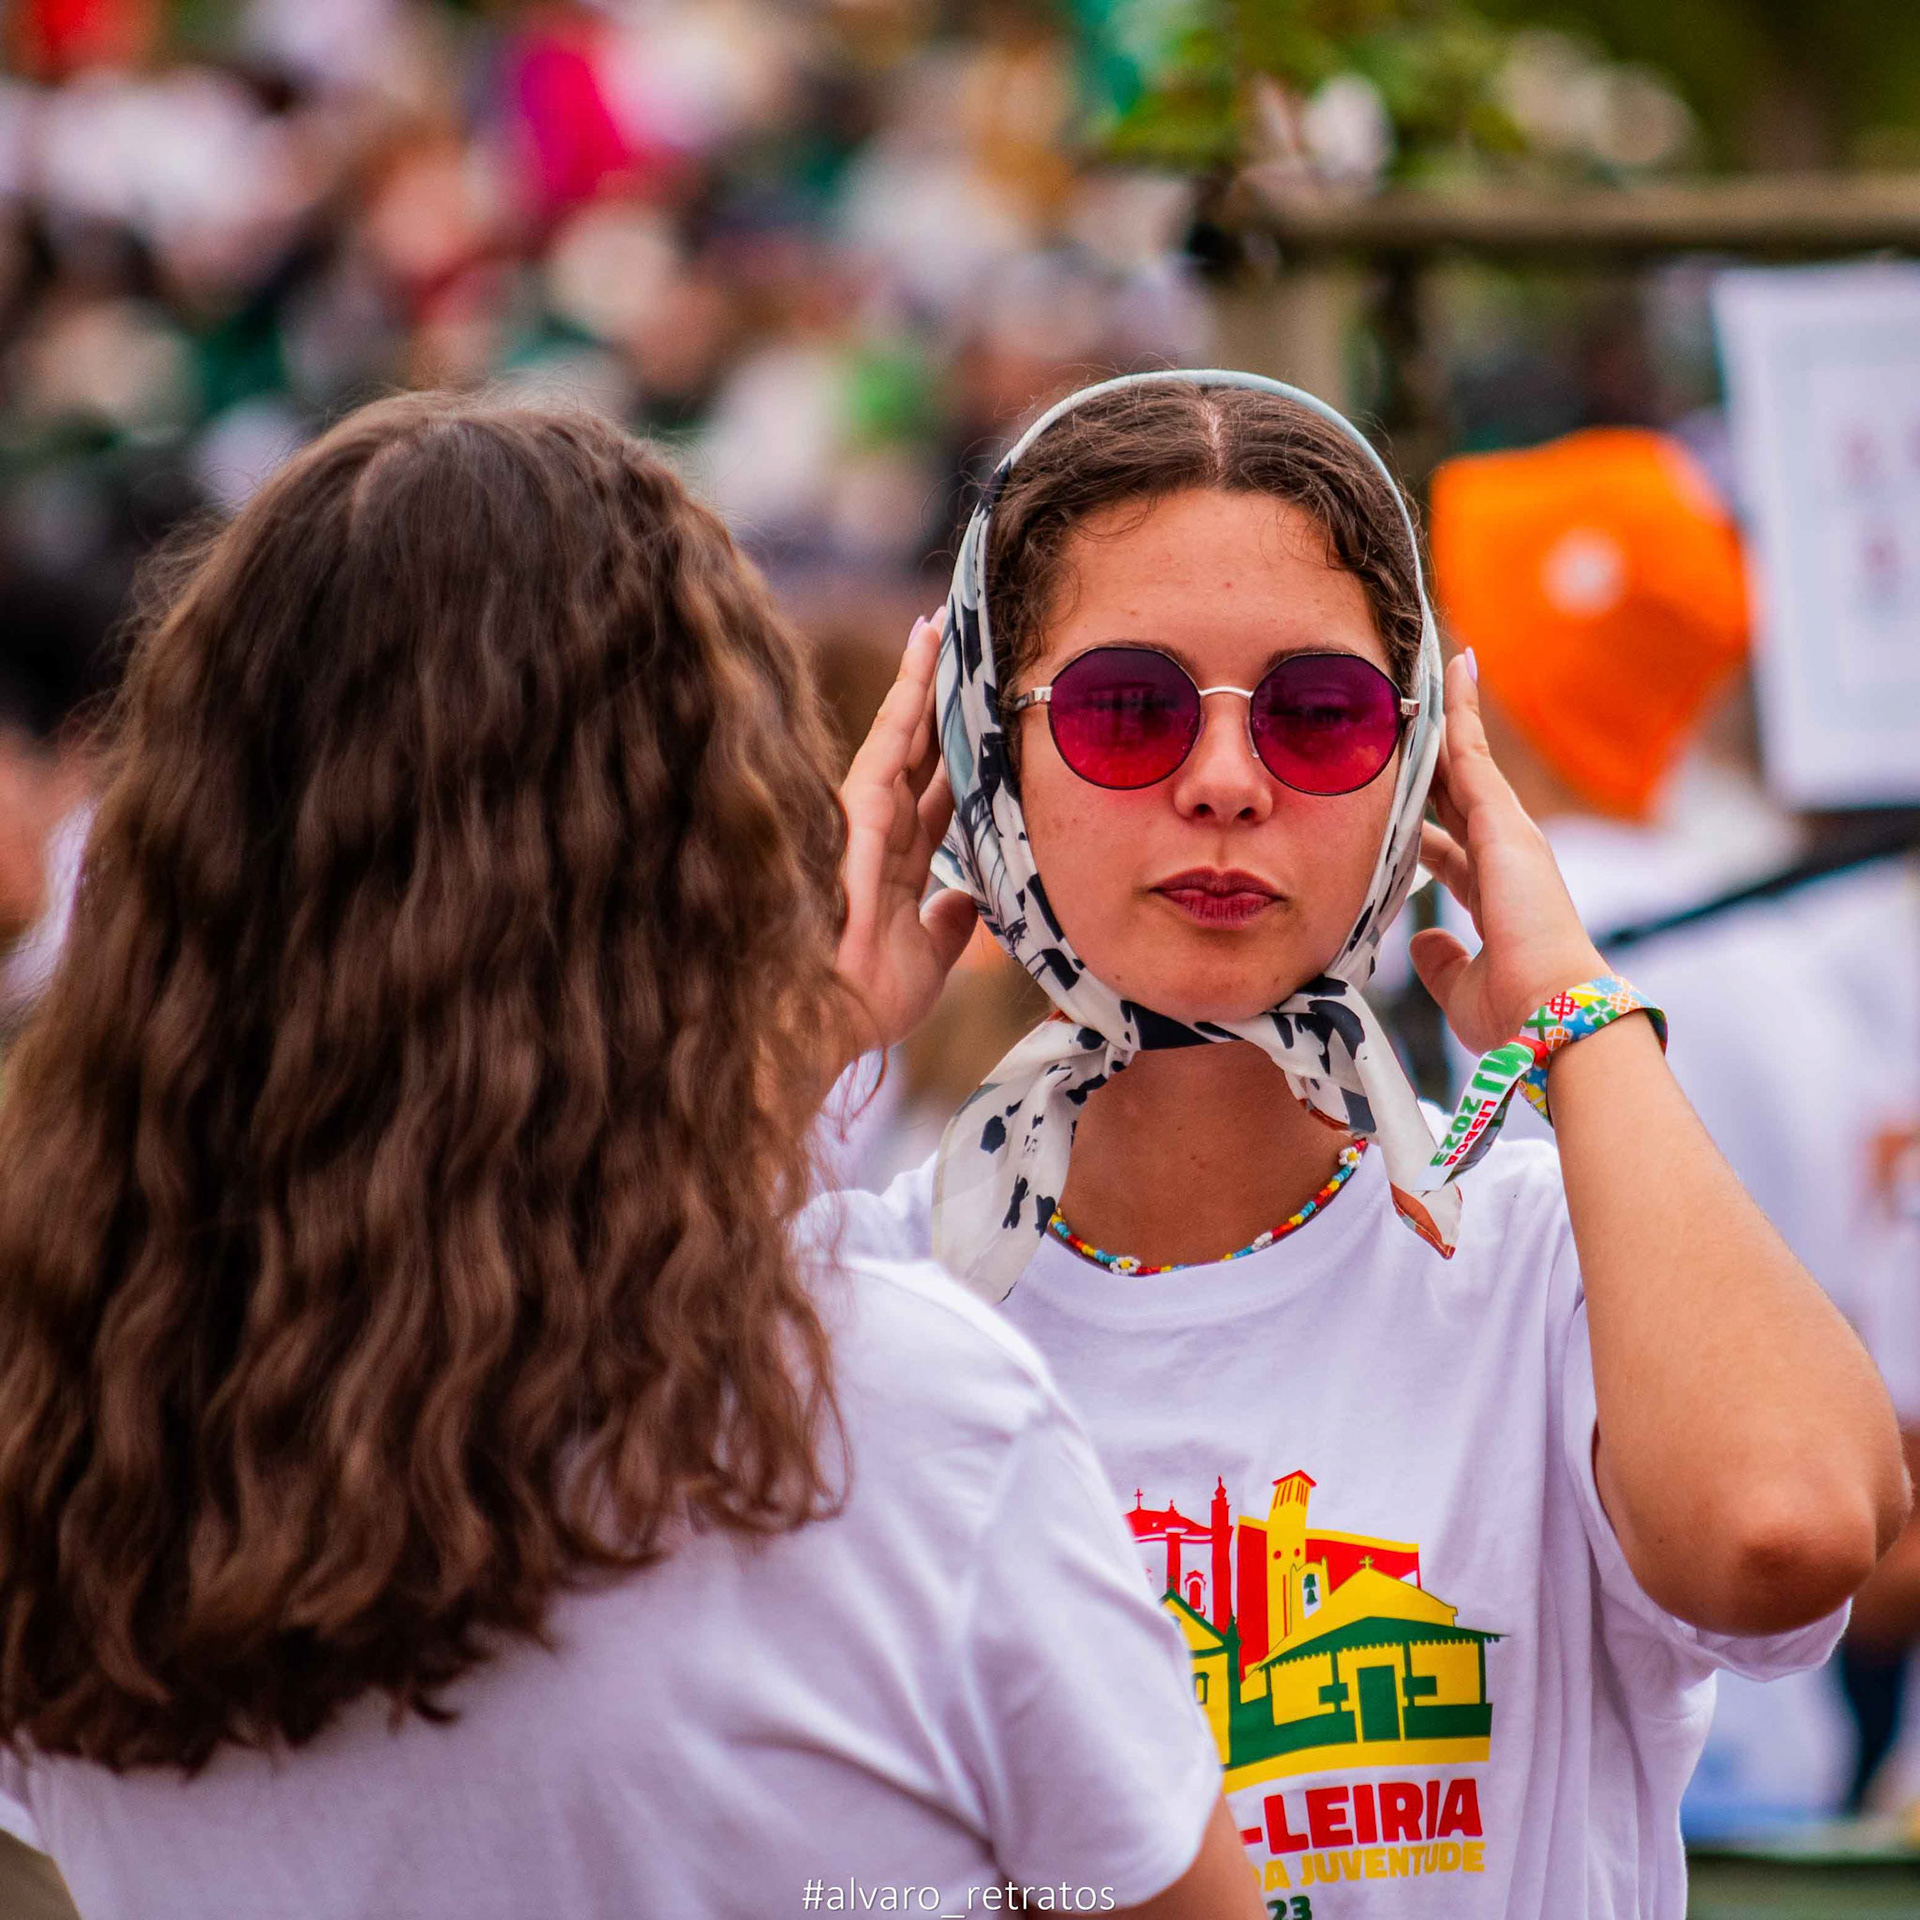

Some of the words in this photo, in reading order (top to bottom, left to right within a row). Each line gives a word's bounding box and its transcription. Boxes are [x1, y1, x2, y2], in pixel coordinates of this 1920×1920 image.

[1429, 1094, 1482, 1167] 2023
[1443, 1099, 1497, 1167] LISBOA
[1301, 1841, 1487, 1887] JUVENTUDE
